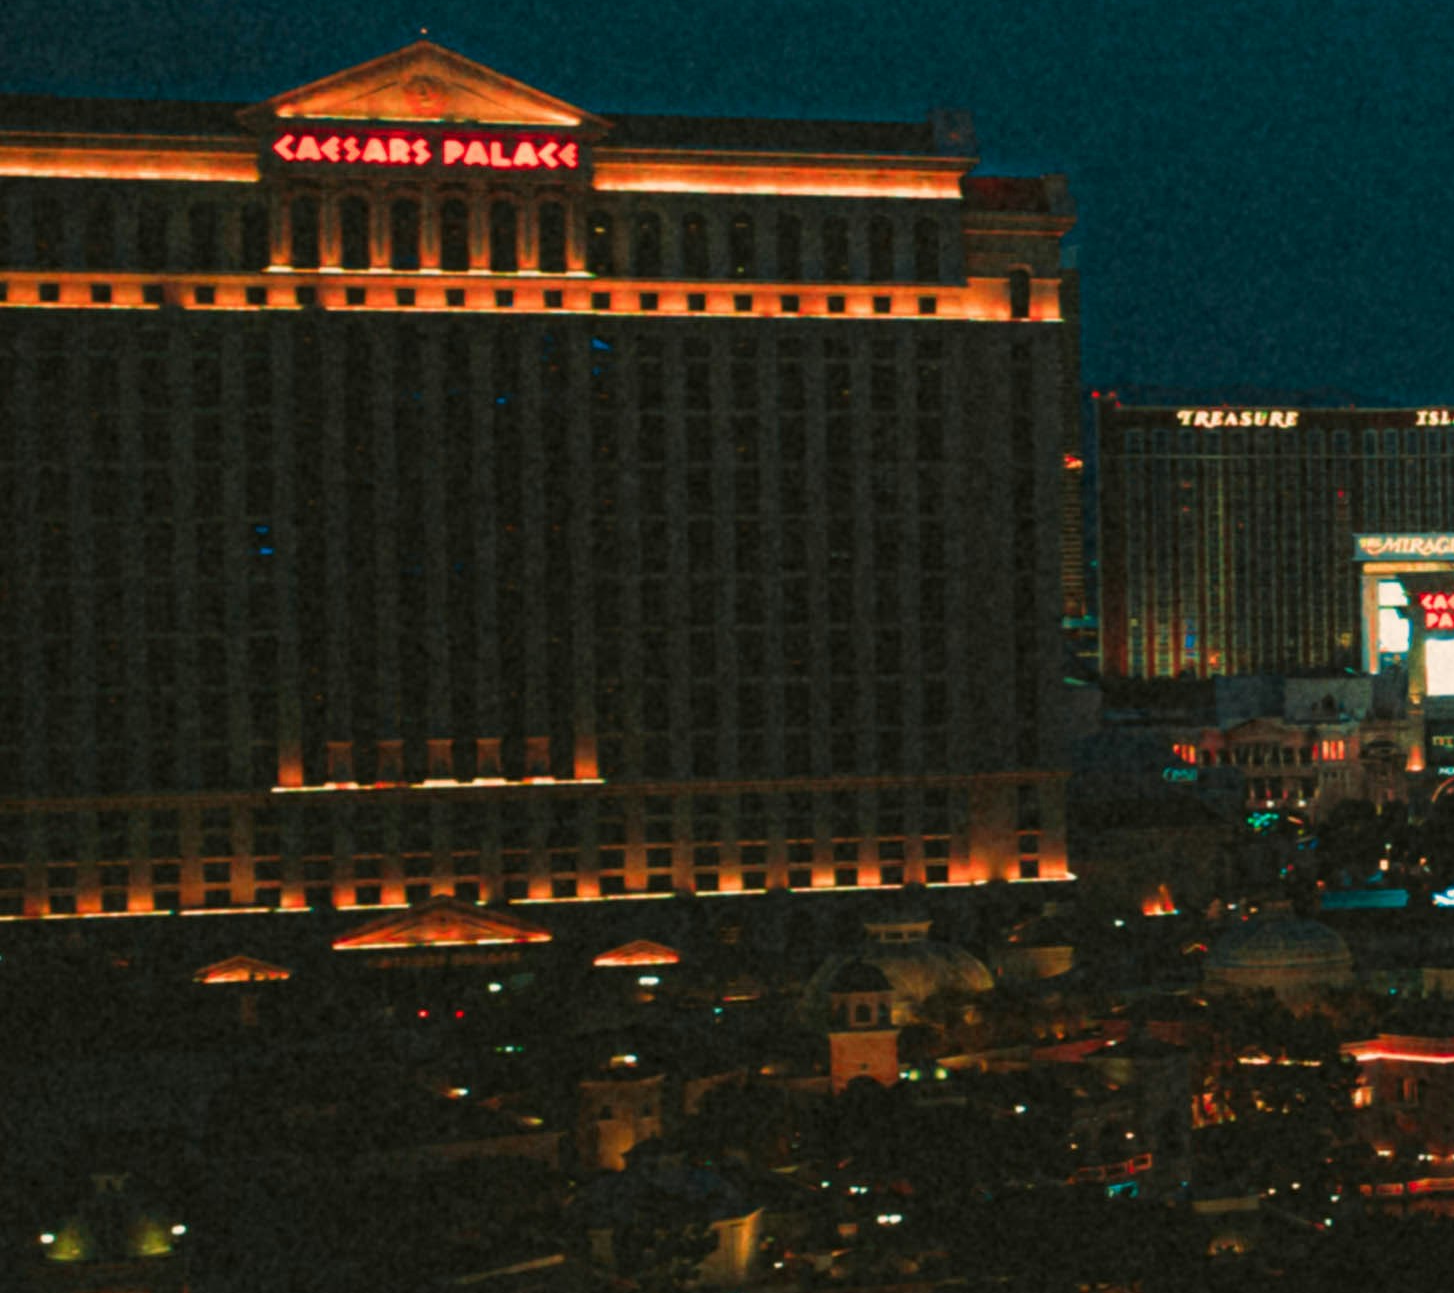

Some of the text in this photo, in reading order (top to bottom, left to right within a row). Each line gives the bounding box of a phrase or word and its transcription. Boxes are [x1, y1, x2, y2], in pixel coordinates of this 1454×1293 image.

[272, 133, 580, 169] CAESARS PALACE
[1177, 411, 1299, 429] TREASURE
